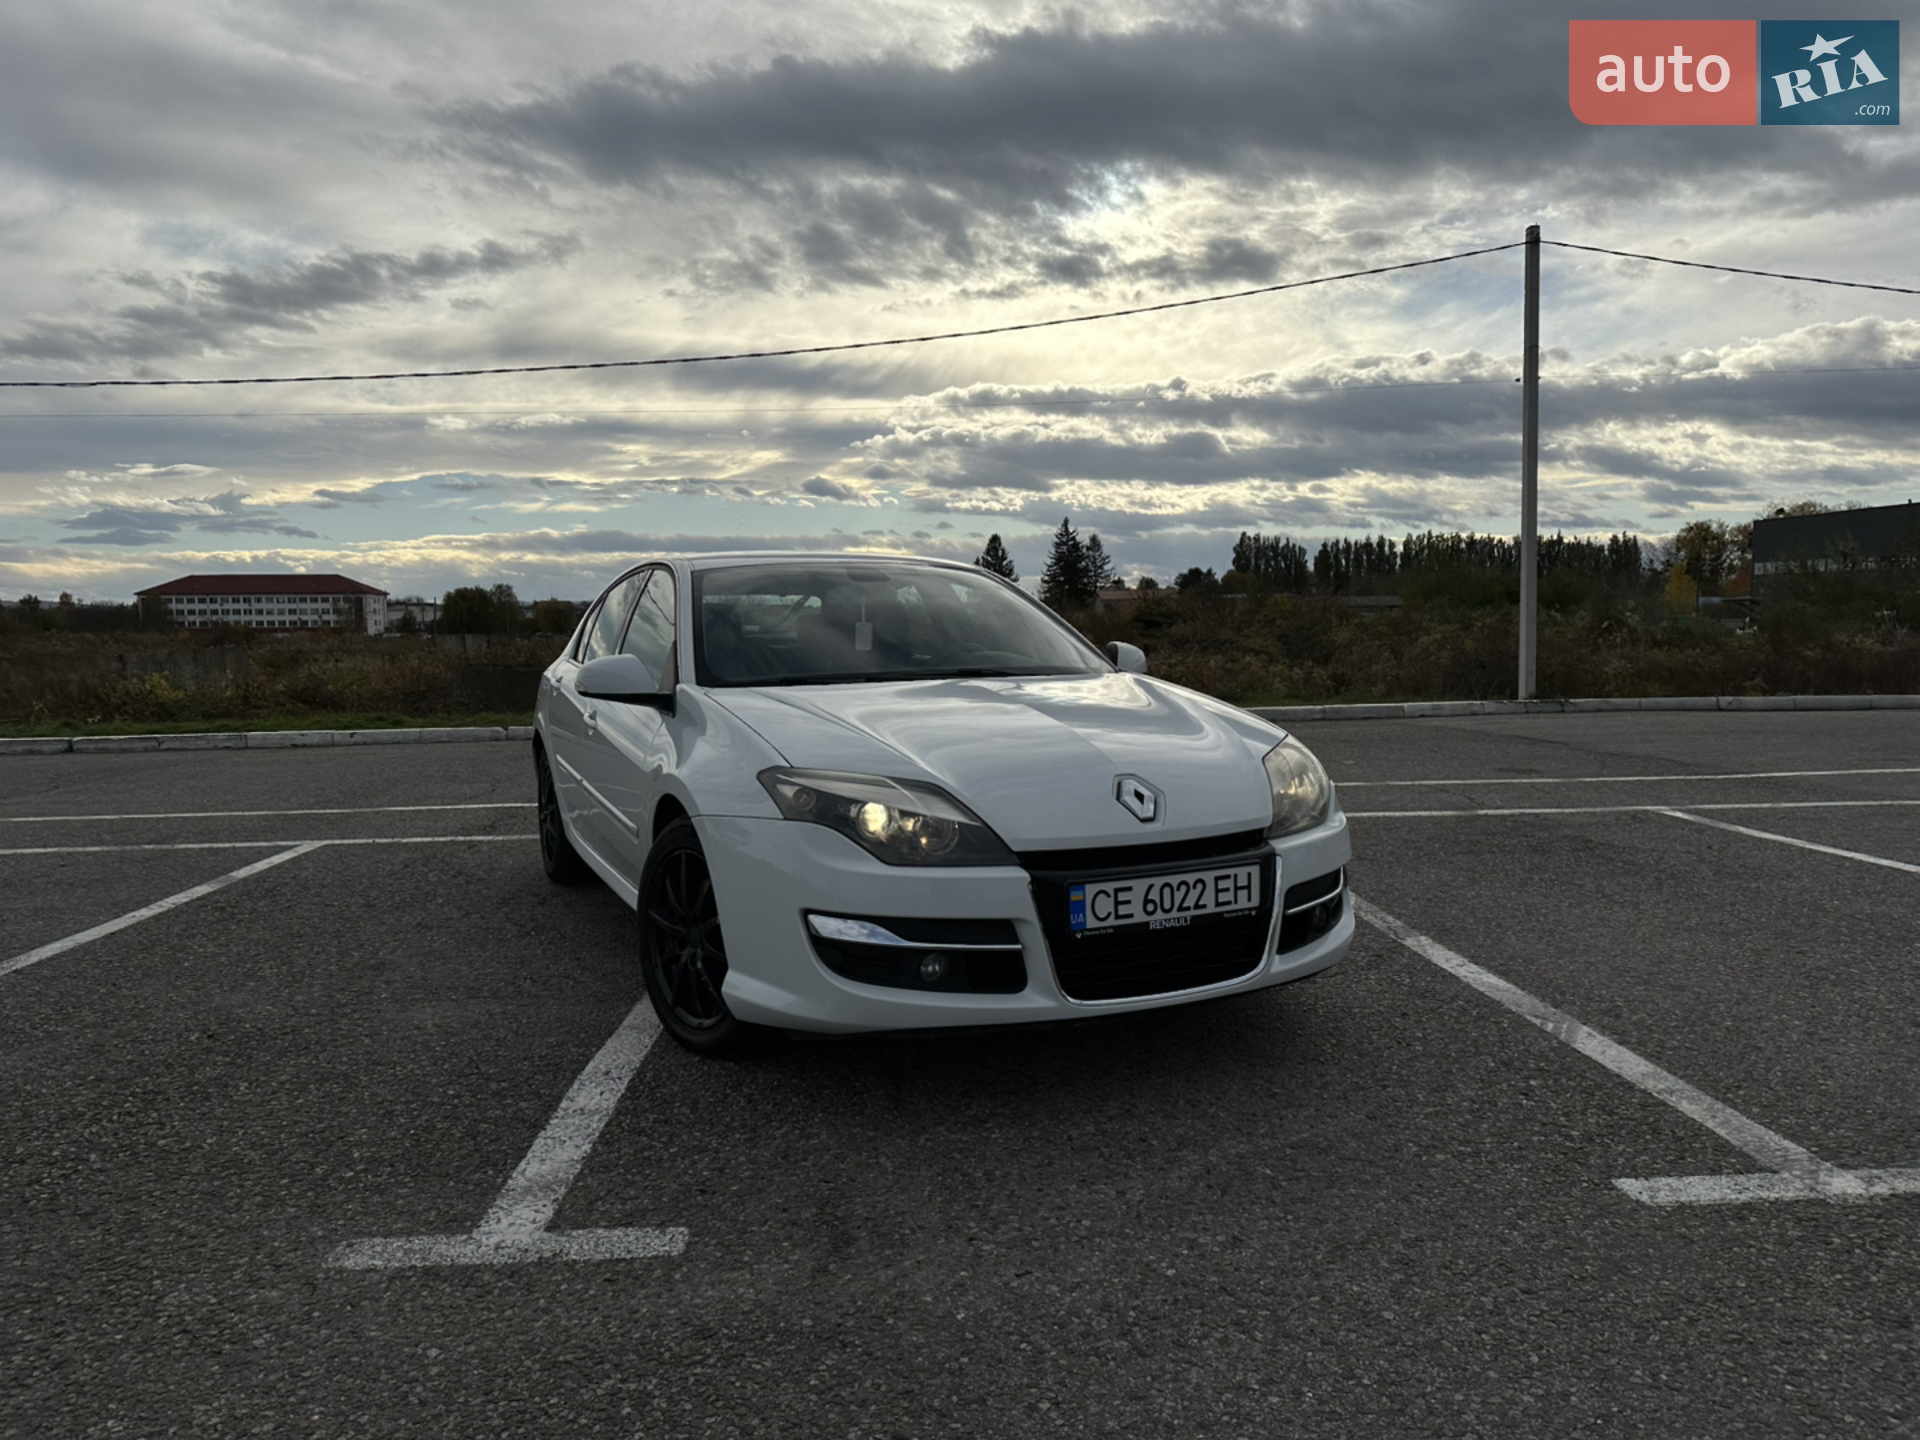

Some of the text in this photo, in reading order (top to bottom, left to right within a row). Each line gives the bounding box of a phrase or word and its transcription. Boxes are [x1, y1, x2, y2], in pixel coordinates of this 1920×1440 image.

[1090, 871, 1252, 922] CE 6022 EH
[1070, 912, 1084, 924] UA
[1149, 915, 1192, 930] RENAULT
